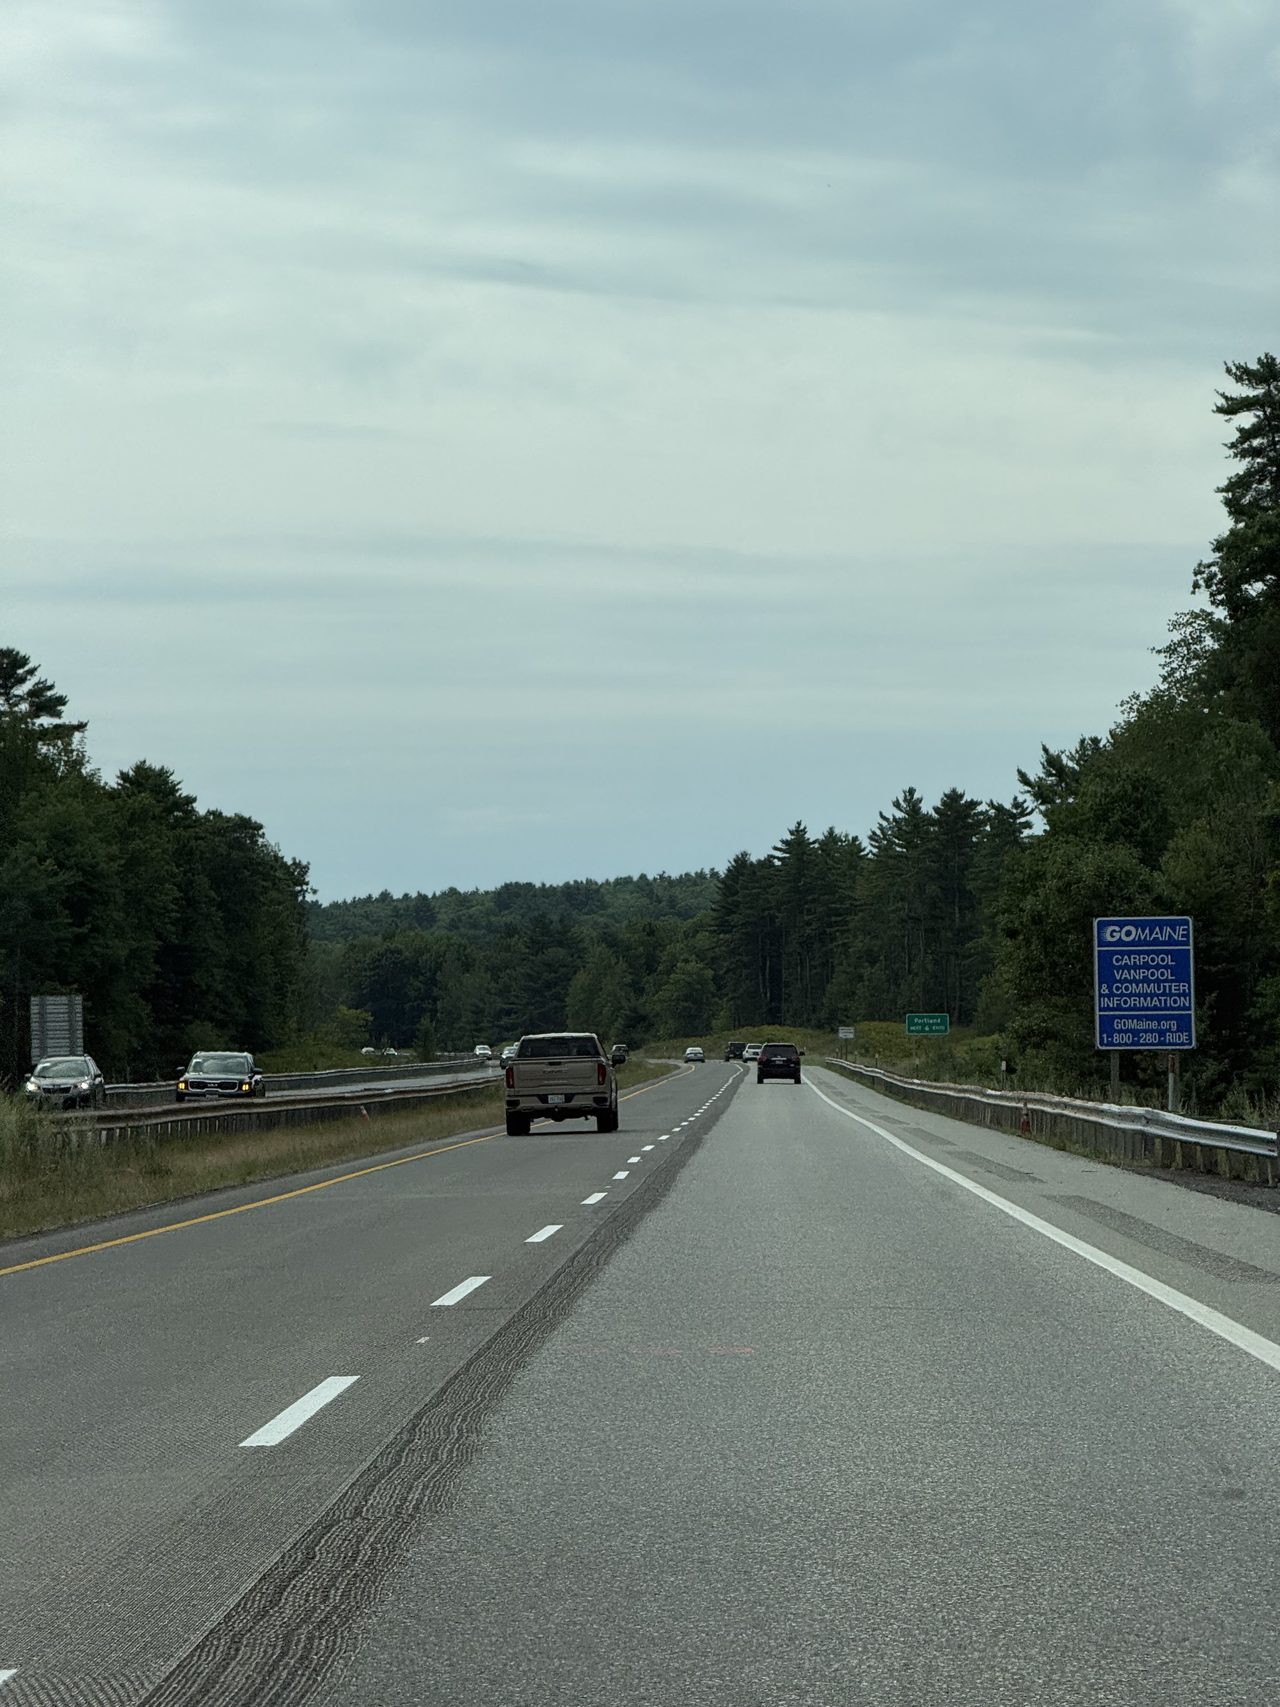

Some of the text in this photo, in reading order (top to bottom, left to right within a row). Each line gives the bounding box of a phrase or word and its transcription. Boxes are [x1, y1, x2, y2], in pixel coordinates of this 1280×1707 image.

[1104, 925, 1188, 942] GOMAINE
[1112, 954, 1176, 965] CARPOOL
[1114, 969, 1176, 980] VANPOOL
[1100, 983, 1189, 994] & COMMUTER
[1100, 996, 1190, 1008] INFORMATION
[1113, 1018, 1177, 1031] GOMaine.org
